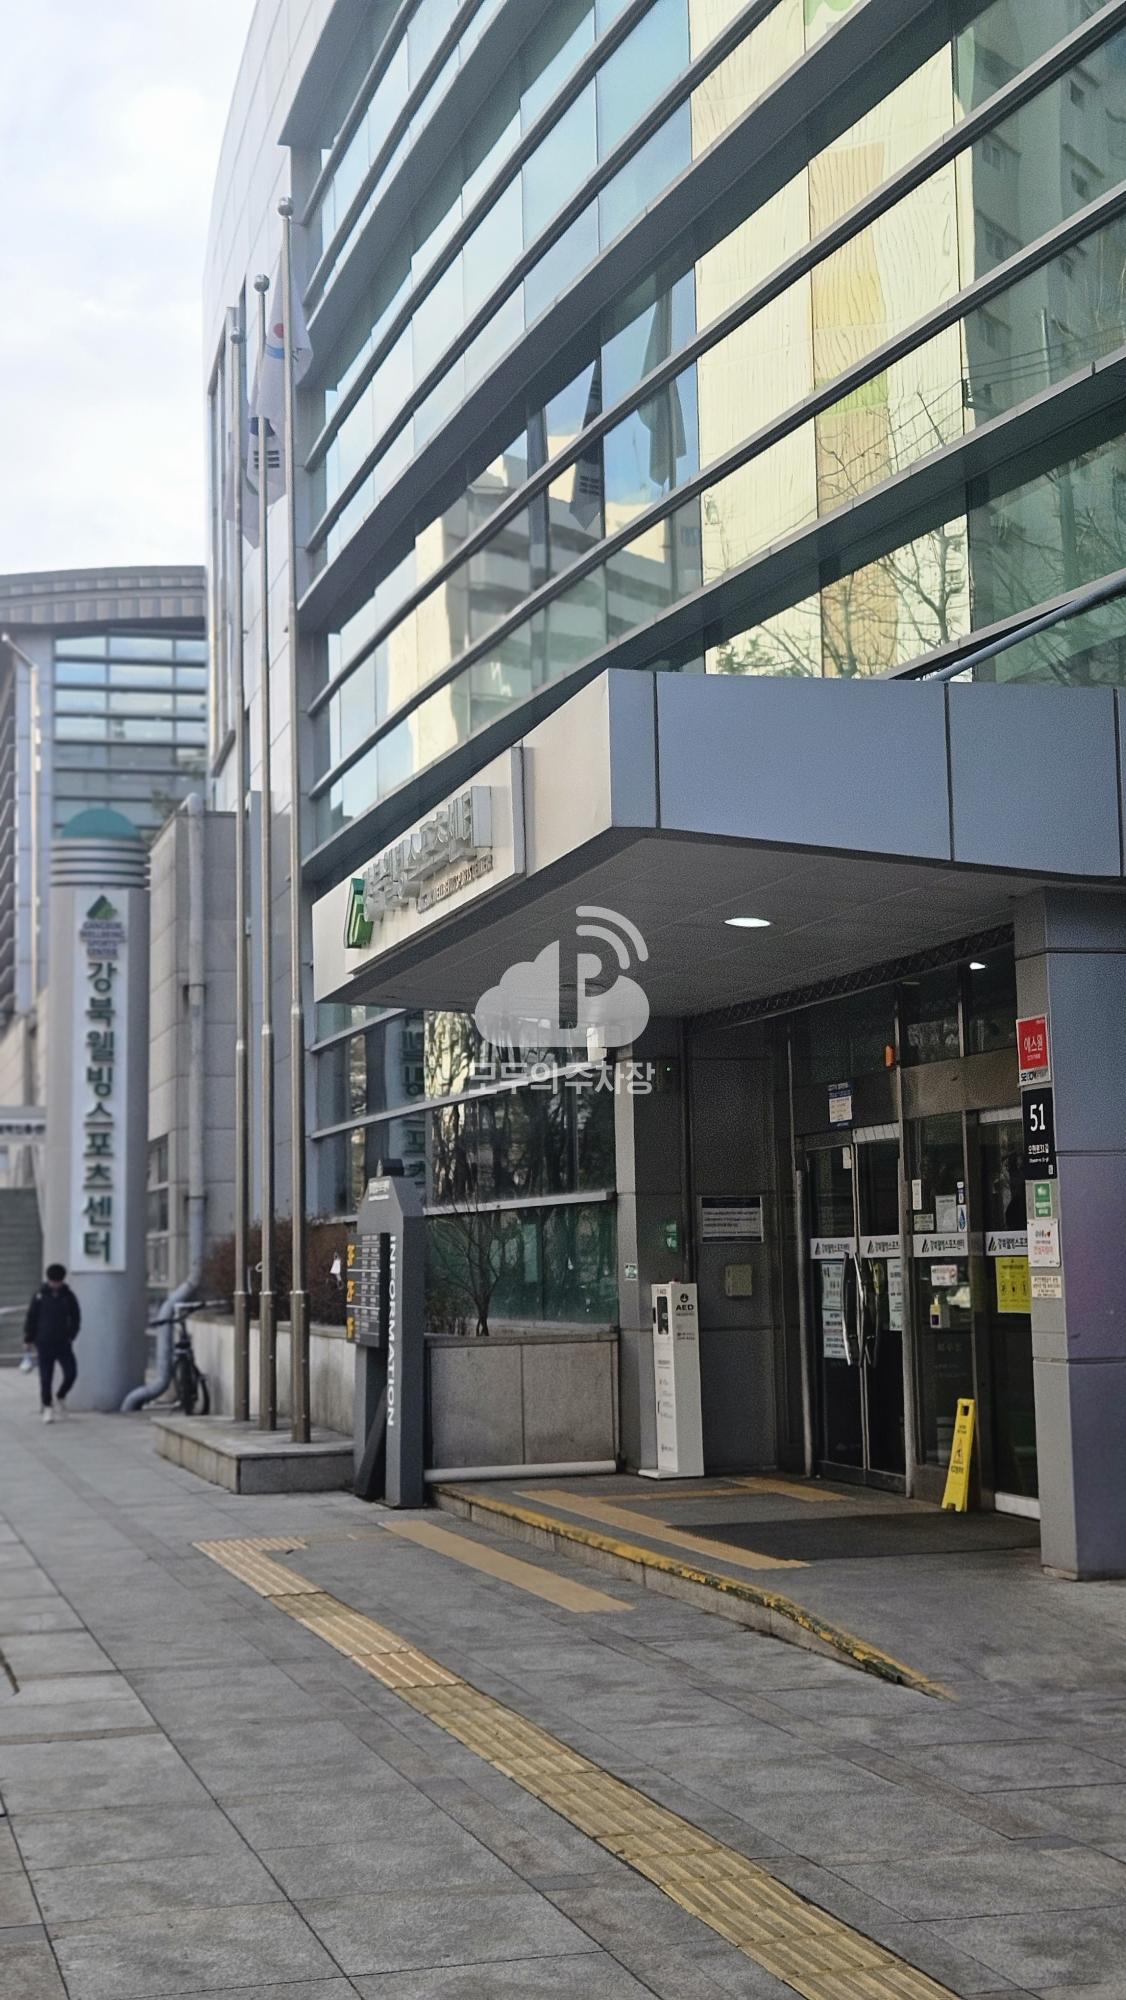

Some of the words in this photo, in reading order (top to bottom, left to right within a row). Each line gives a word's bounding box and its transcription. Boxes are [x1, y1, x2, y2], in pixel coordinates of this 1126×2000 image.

[1024, 1034, 1042, 1053] 에스원
[84, 962, 118, 1265] 강북웰빙스포츠센터
[1030, 1103, 1046, 1131] 51
[387, 1236, 397, 1427] INFORMATION
